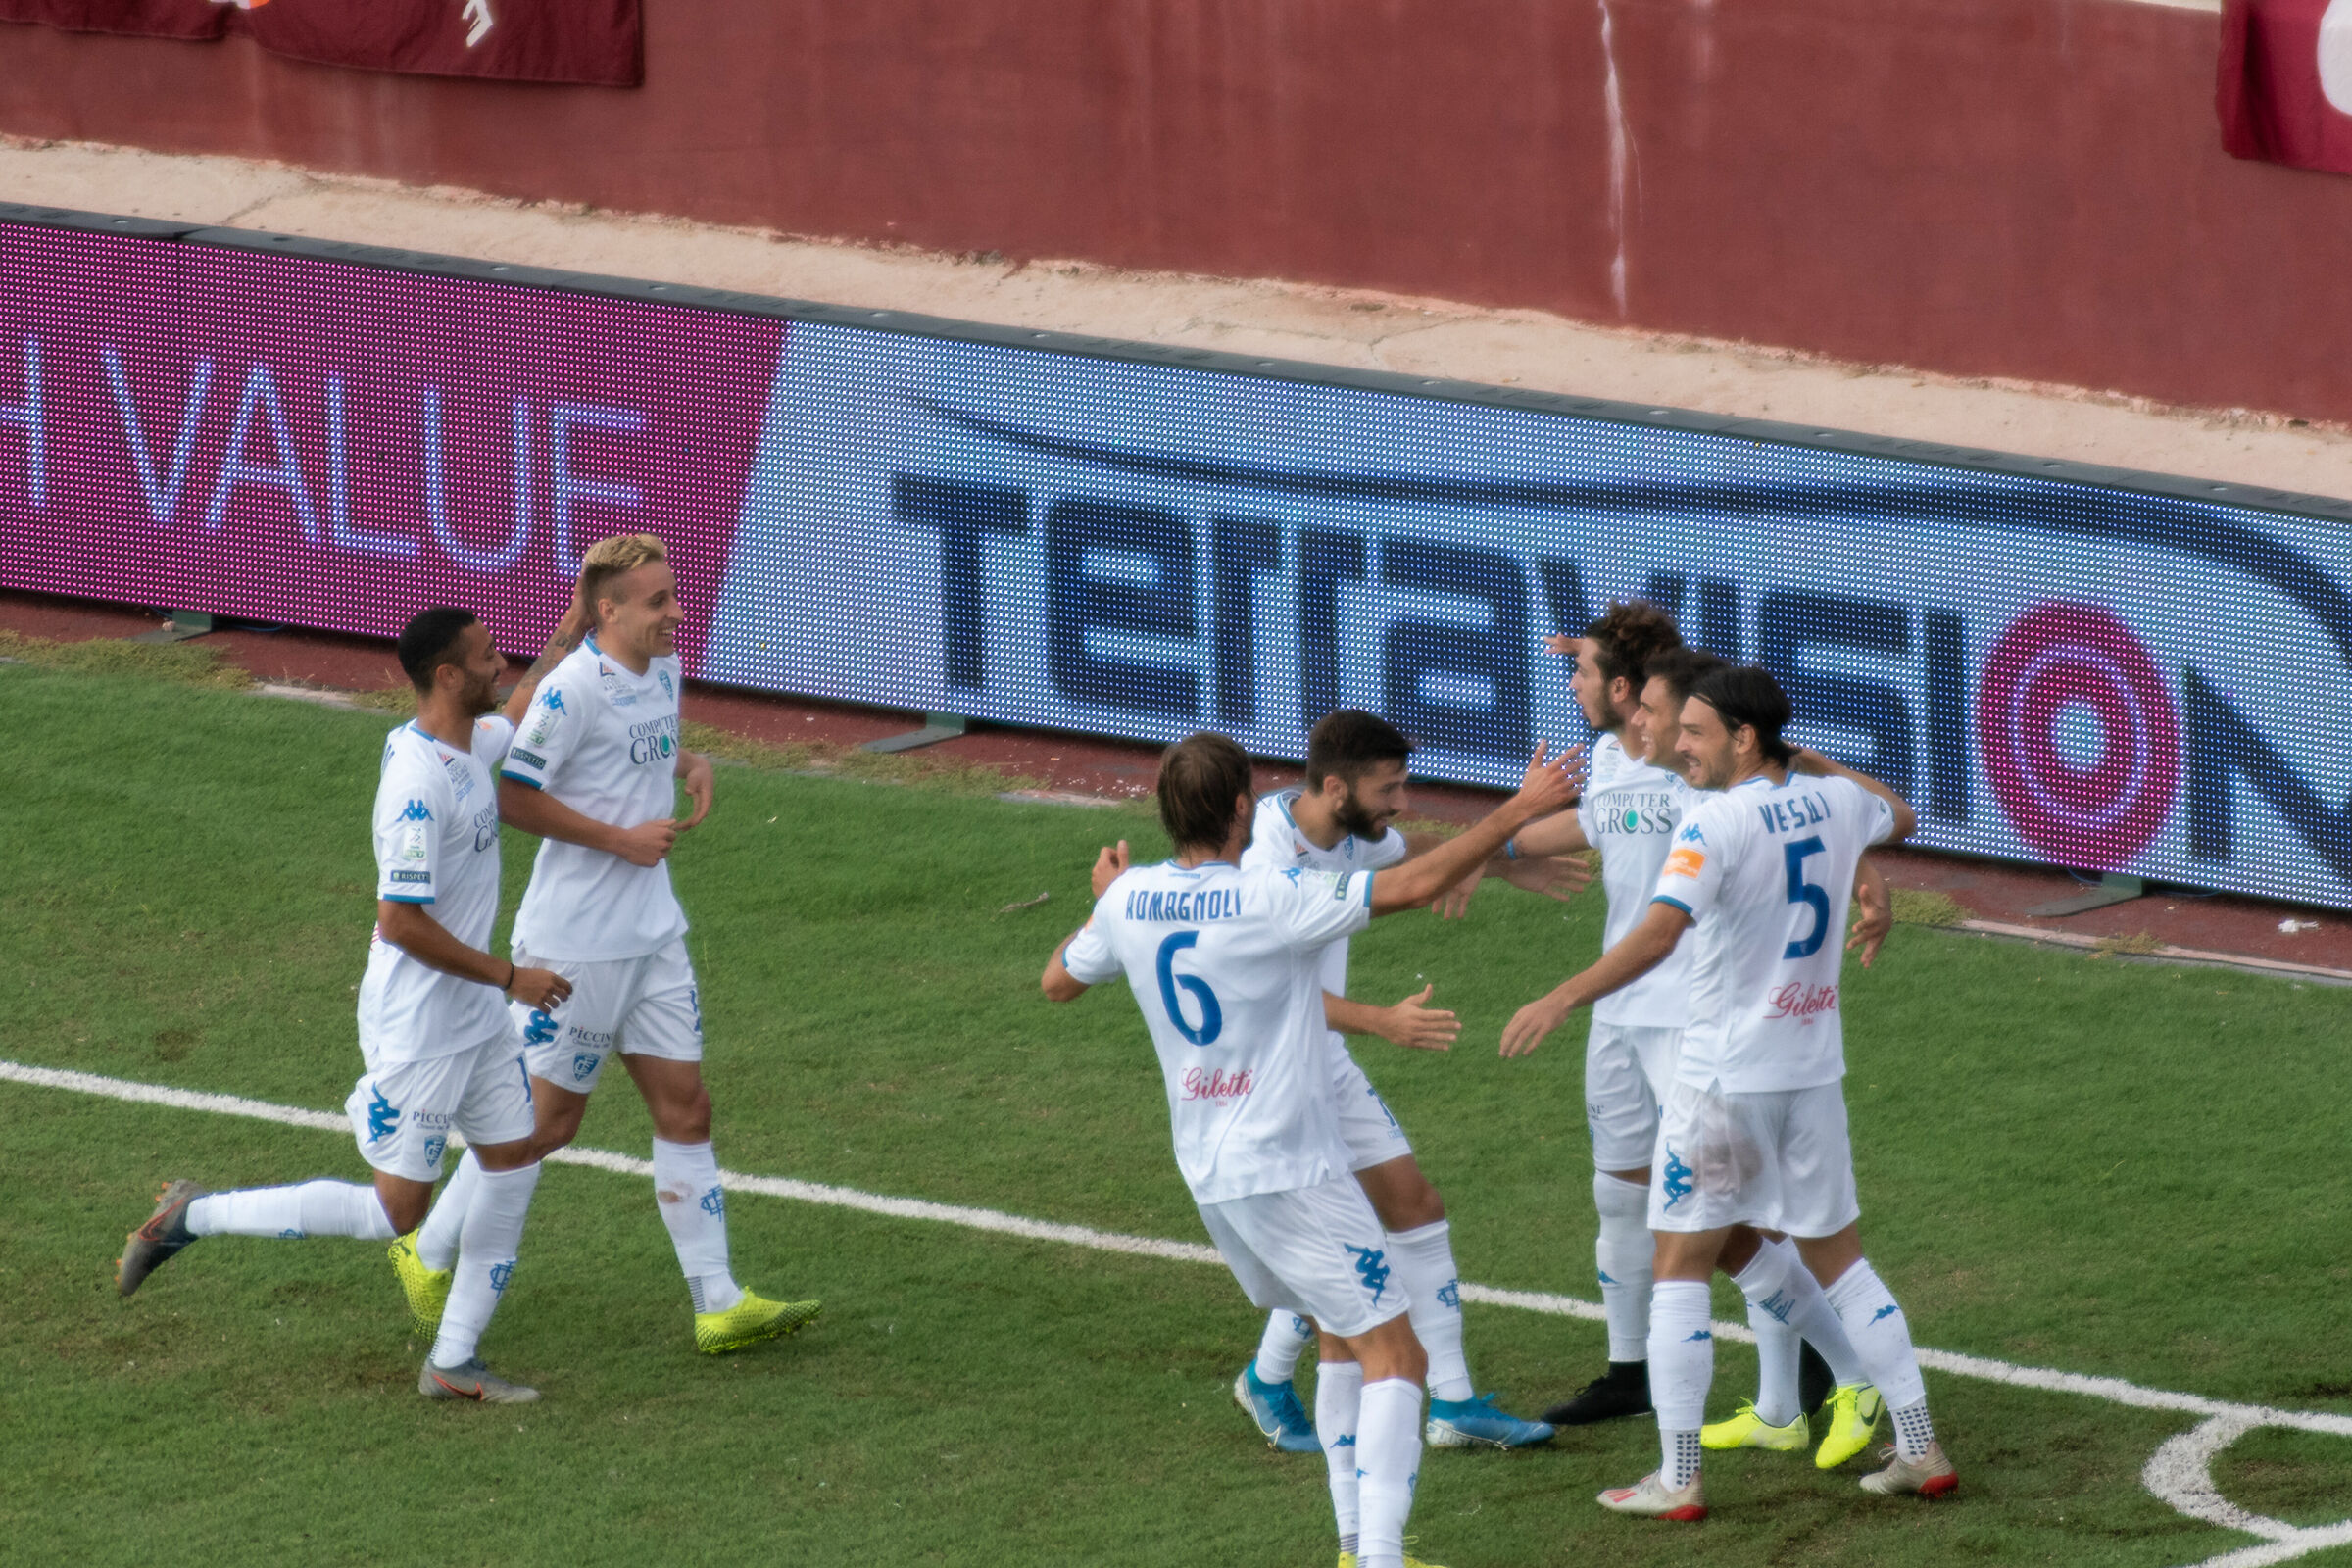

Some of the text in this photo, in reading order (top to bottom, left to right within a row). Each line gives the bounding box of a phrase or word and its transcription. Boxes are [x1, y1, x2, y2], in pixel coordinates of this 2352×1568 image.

[100, 339, 647, 580] VALUE
[630, 729, 678, 765] GROS
[1597, 792, 1670, 807] COMPUTER
[1596, 808, 1673, 834] GROSS
[1126, 888, 1241, 921] ROMAGNOLI
[1782, 834, 1830, 959] 5
[1156, 930, 1222, 1046] 6
[1763, 981, 1838, 1019] Giletti
[1181, 1067, 1253, 1101] Giletti
